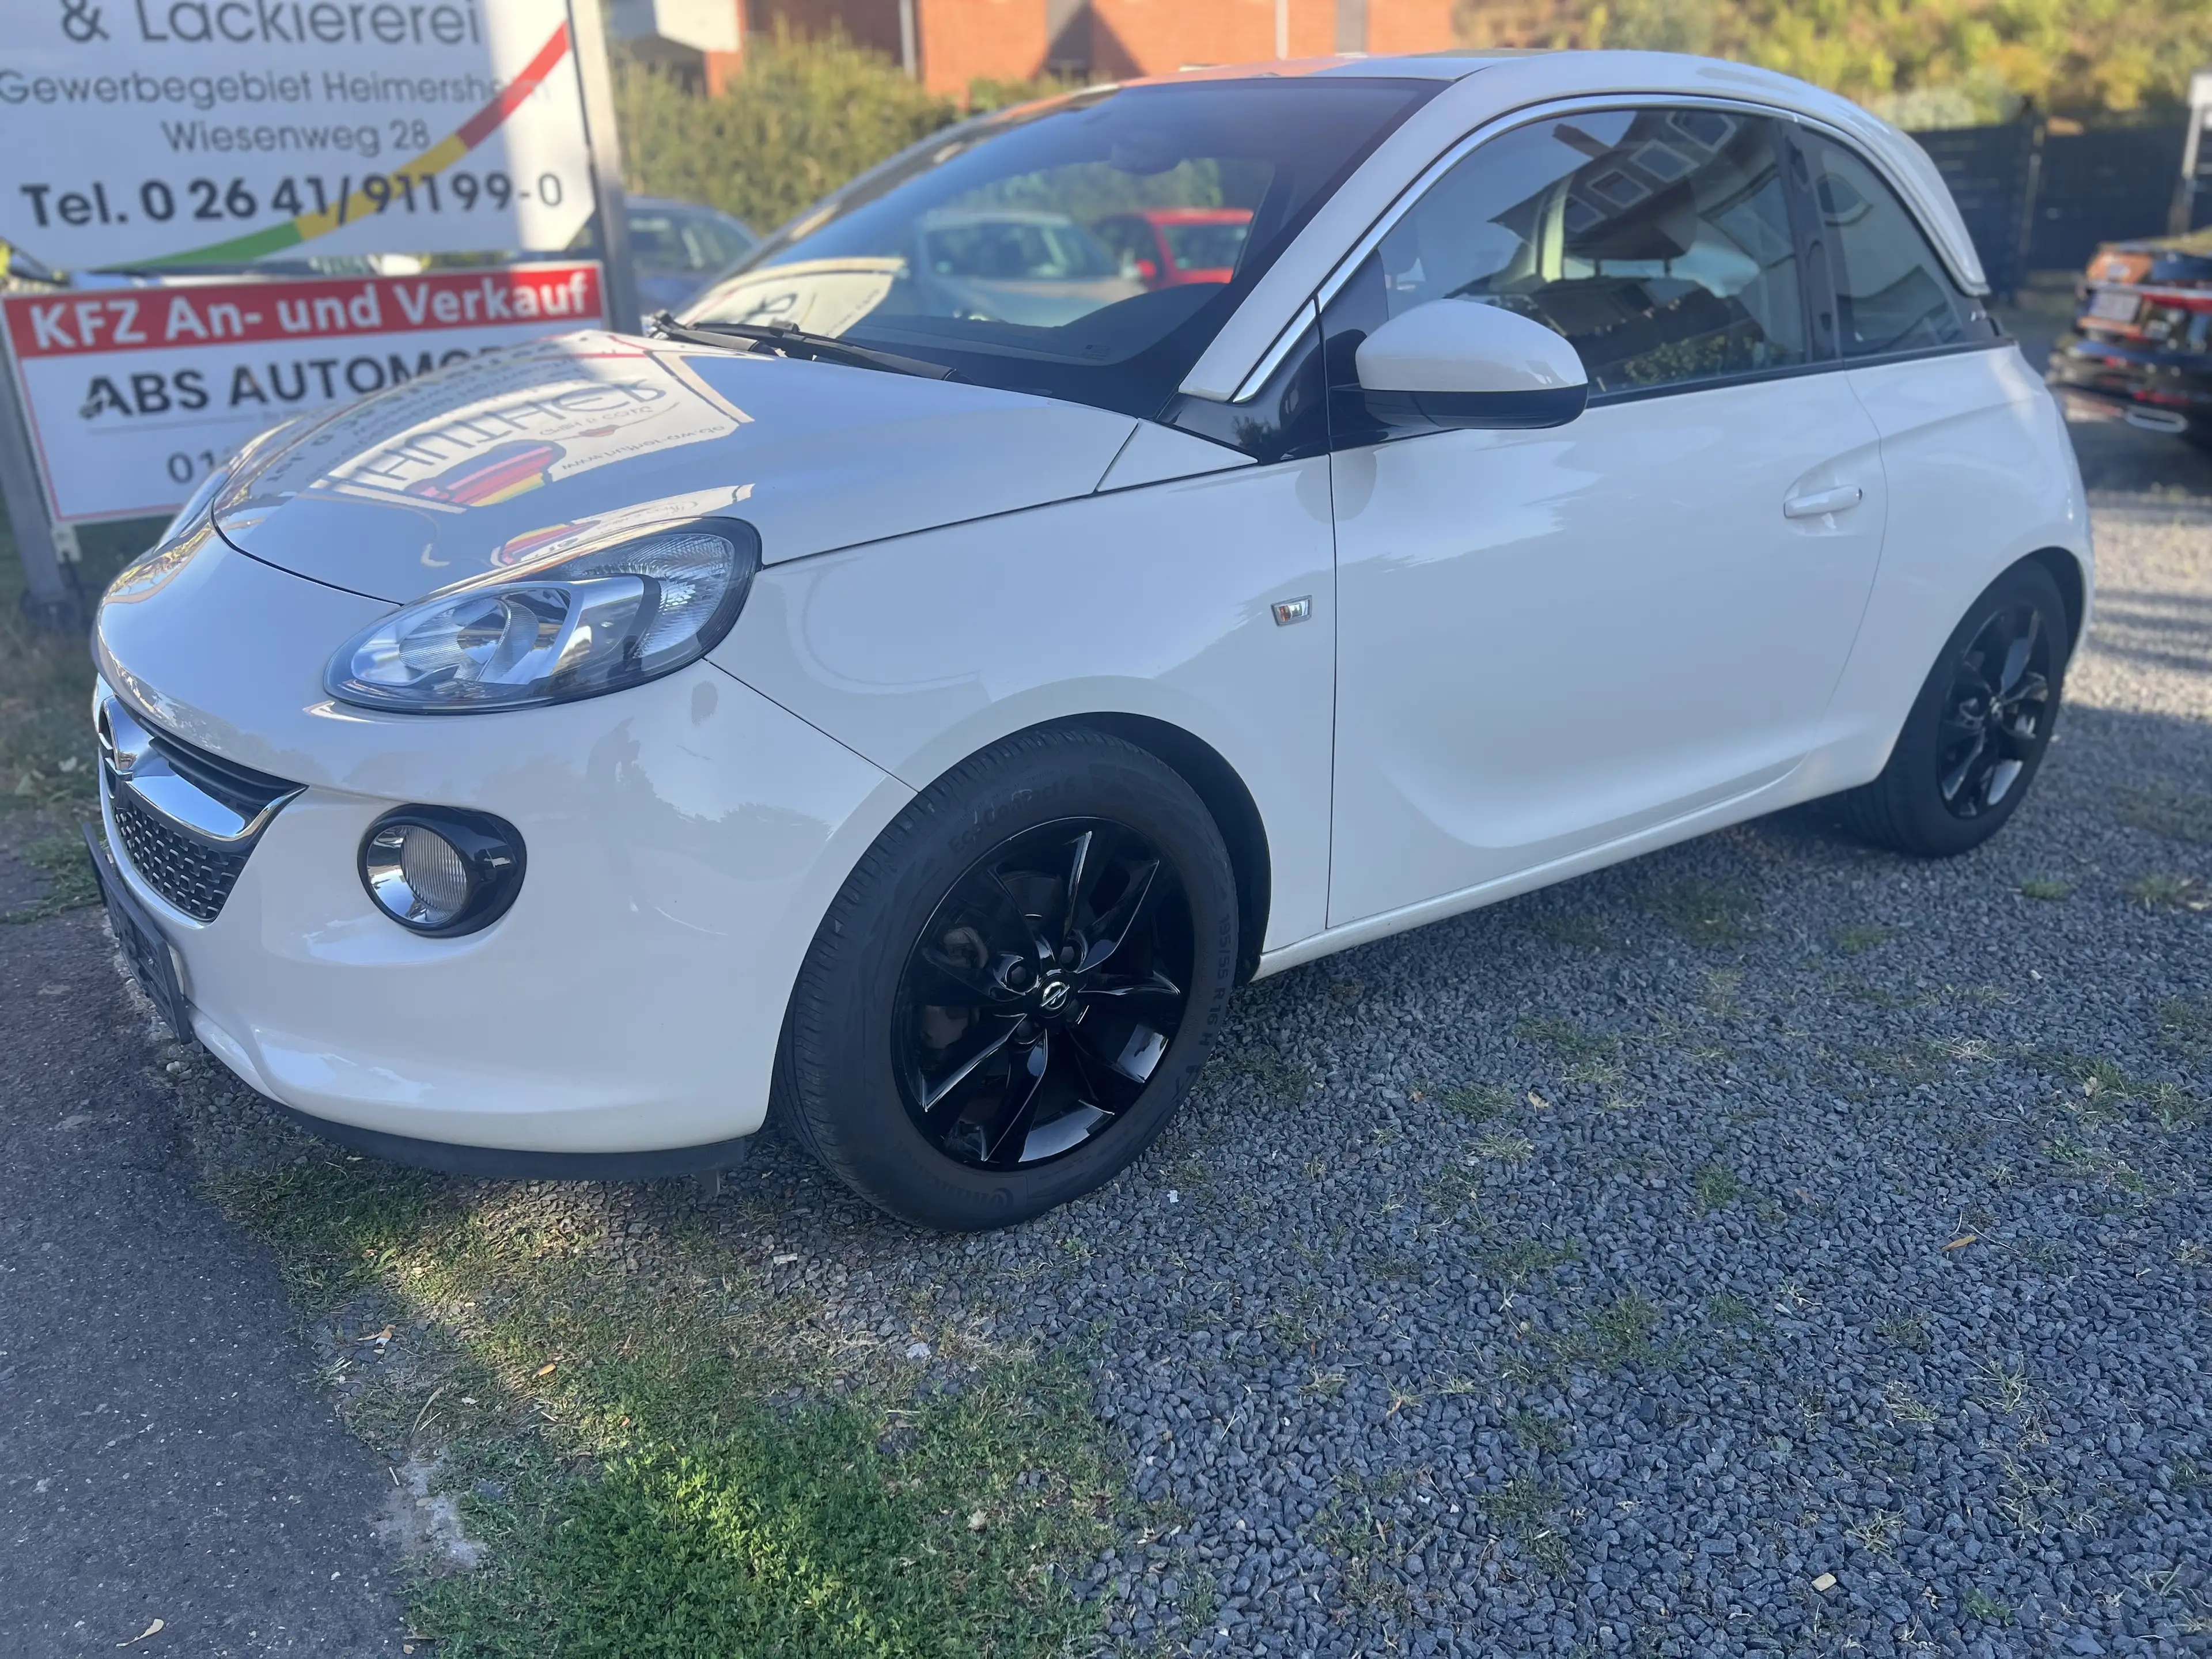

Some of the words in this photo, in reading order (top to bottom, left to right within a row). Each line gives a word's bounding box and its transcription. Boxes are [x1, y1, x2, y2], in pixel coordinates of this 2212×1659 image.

[61, 0, 111, 43] &
[134, 0, 482, 44] Lackiererei
[0, 68, 312, 110] Gewerbegebiet
[161, 120, 381, 158] Wiesenweg
[389, 119, 431, 151] 28
[20, 181, 128, 227] Tel.
[29, 299, 147, 350] KFZ
[164, 296, 263, 341] An-
[277, 283, 382, 332] und
[394, 271, 589, 325] Verkauf
[81, 368, 211, 420] ABS
[228, 346, 505, 408] AUTOM
[166, 448, 233, 484] 01
[1217, 912, 1232, 980] 195/55
